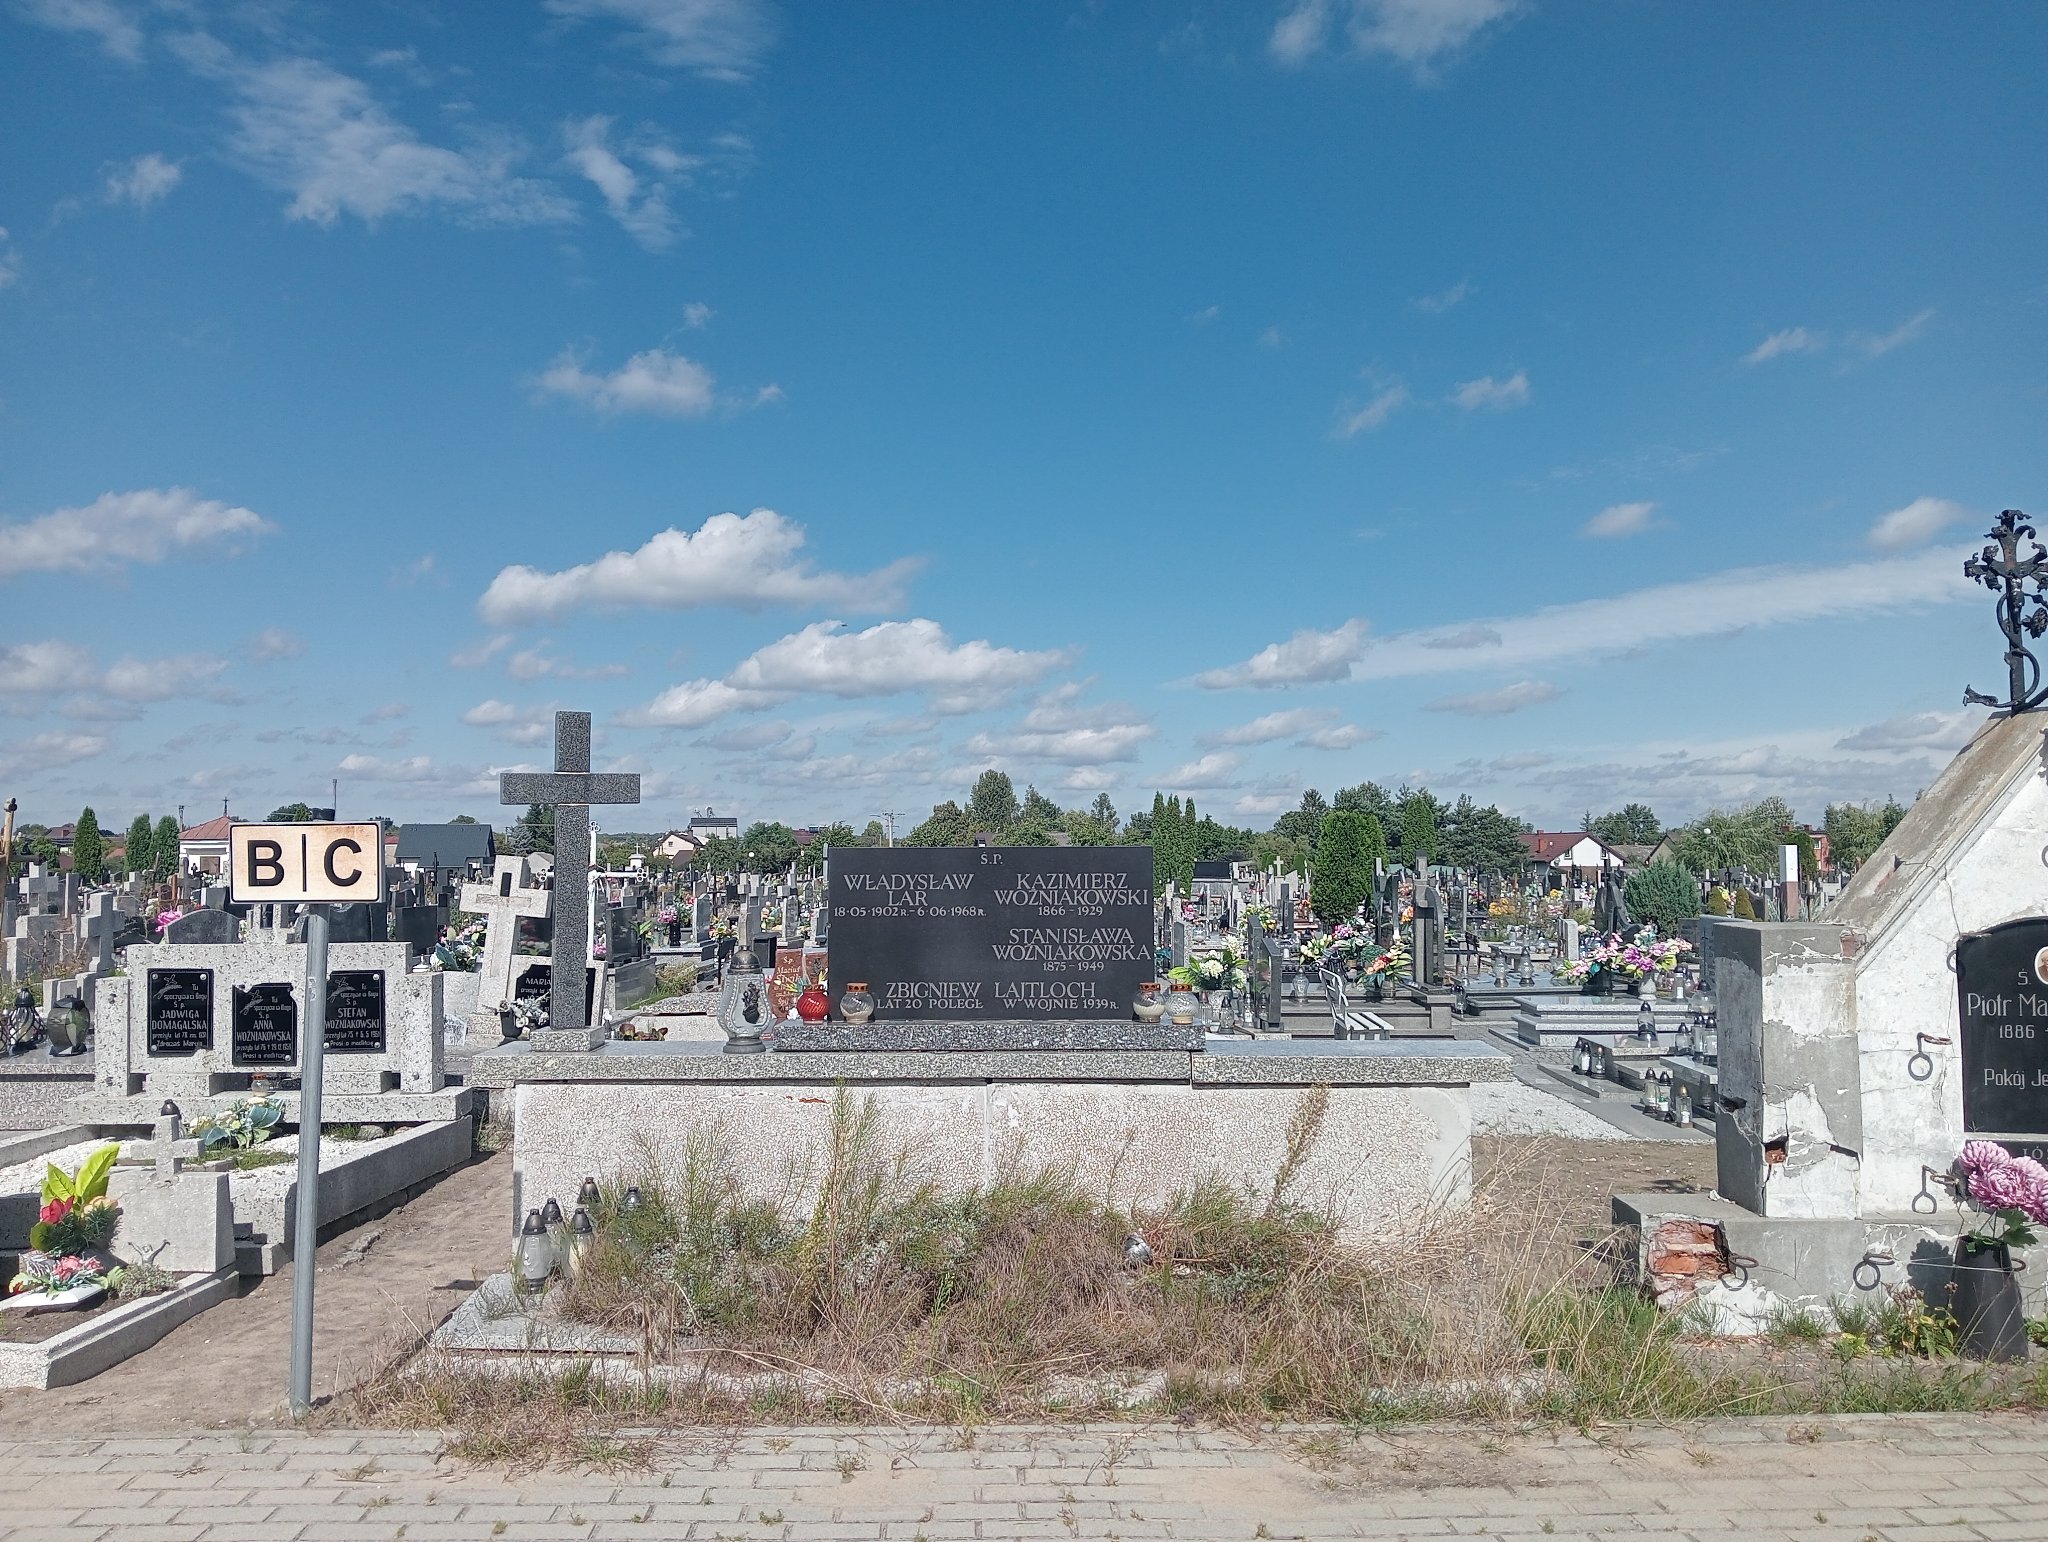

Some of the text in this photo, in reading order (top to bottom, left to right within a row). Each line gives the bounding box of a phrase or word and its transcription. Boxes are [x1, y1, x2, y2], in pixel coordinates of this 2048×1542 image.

[247, 838, 362, 887] B C
[843, 873, 975, 891] WŁADYSŁAW
[1016, 873, 1128, 890] KAZIMIERZ
[888, 890, 928, 907] LAR
[993, 887, 1149, 906] WOŹNIAKOWSKI
[1038, 906, 1066, 916] 1866
[1077, 906, 1103, 916] 1929
[1008, 927, 1135, 945] STANISŁAWA
[991, 943, 1152, 961] WOŹNIAKOWSKA
[1042, 961, 1067, 972] 1875
[1077, 961, 1105, 972] 1949
[885, 982, 1096, 1001] ZBIGNIEW LAJTLOCH
[337, 1007, 367, 1018] STEFAN
[876, 999, 902, 1009] LAT
[905, 999, 922, 1009] 20
[928, 999, 984, 1009] POLEGŁ
[1002, 999, 1018, 1009] W
[1024, 999, 1078, 1012] WOJNIE
[1967, 992, 2012, 1017] Piotr
[159, 1009, 200, 1019] JADWIGA
[151, 1020, 207, 1030] DOMAGALSKA
[252, 1020, 274, 1030] ANNA
[1999, 1024, 2035, 1039] 1886
[1983, 1068, 2025, 1090] Pokój
